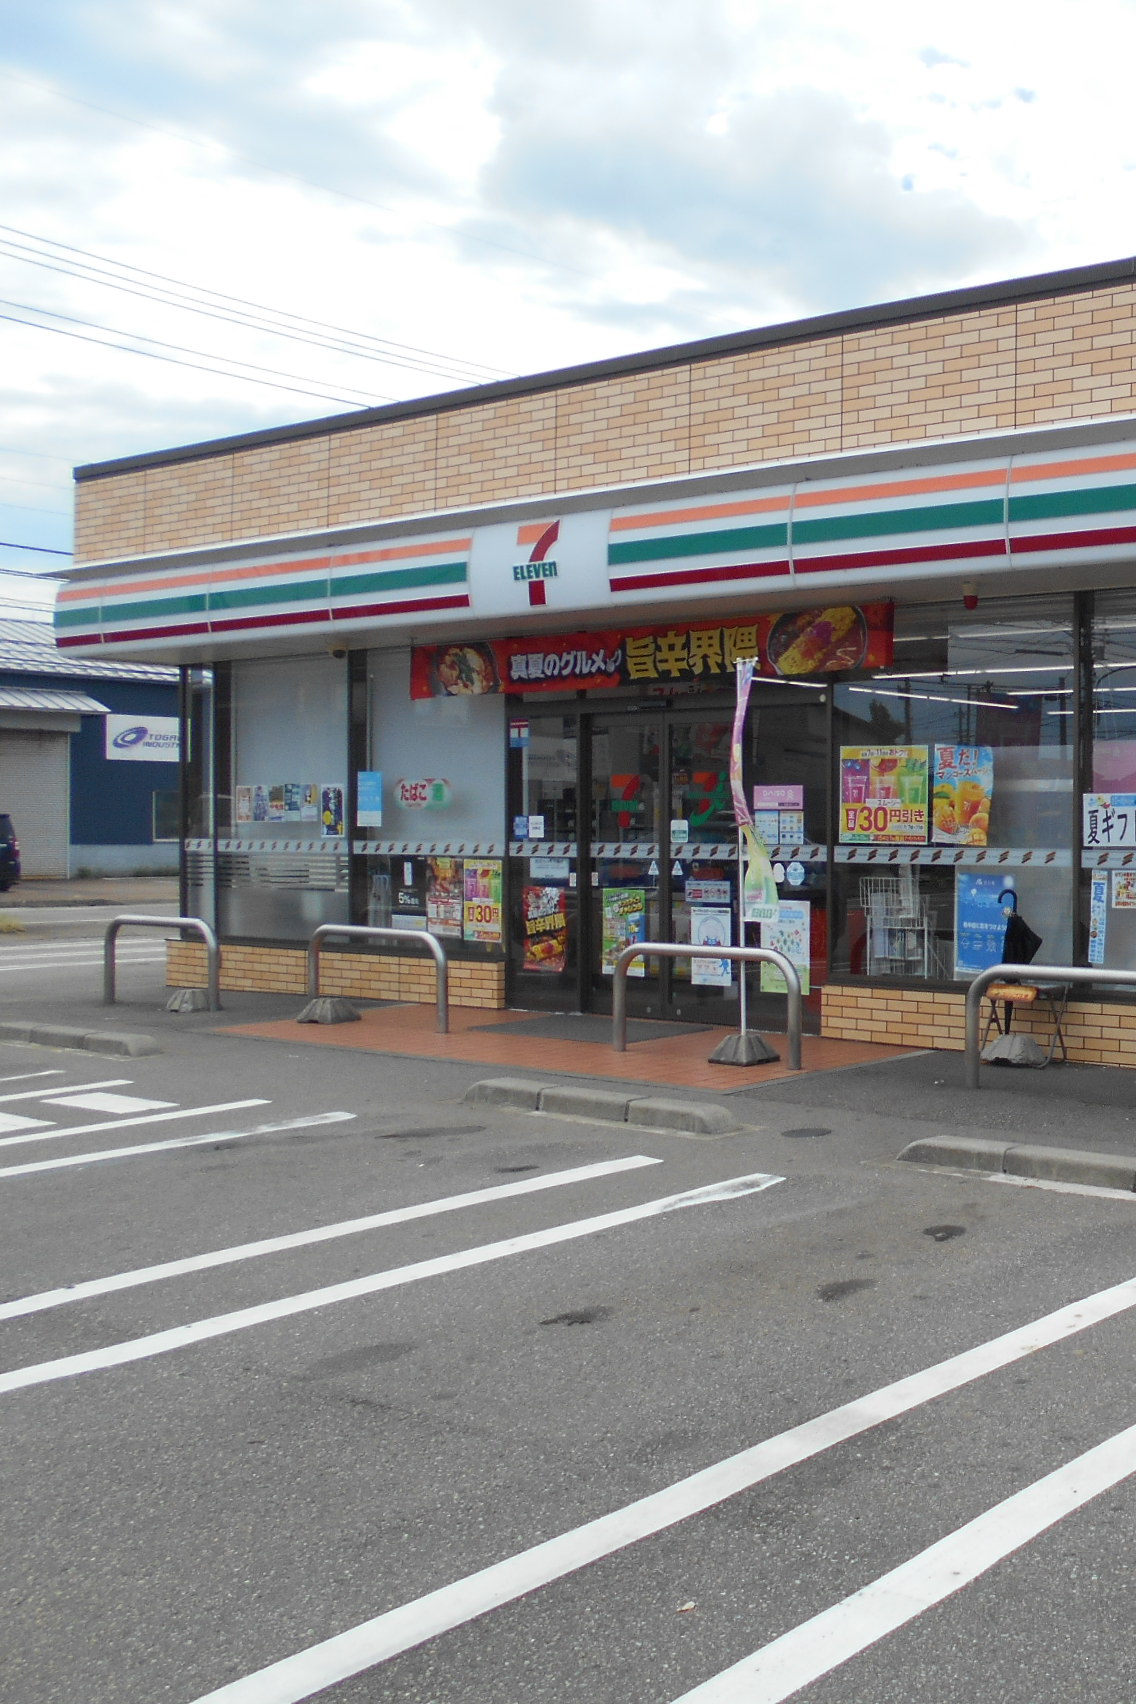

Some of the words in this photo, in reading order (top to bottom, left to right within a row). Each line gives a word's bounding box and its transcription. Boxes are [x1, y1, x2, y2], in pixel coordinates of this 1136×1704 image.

[510, 648, 607, 680] 真夏のグルメ
[625, 624, 761, 680] 旨辛界隈
[149, 733, 180, 741] TOGA
[400, 783, 428, 801] たばこ
[859, 807, 925, 832] 30円引き
